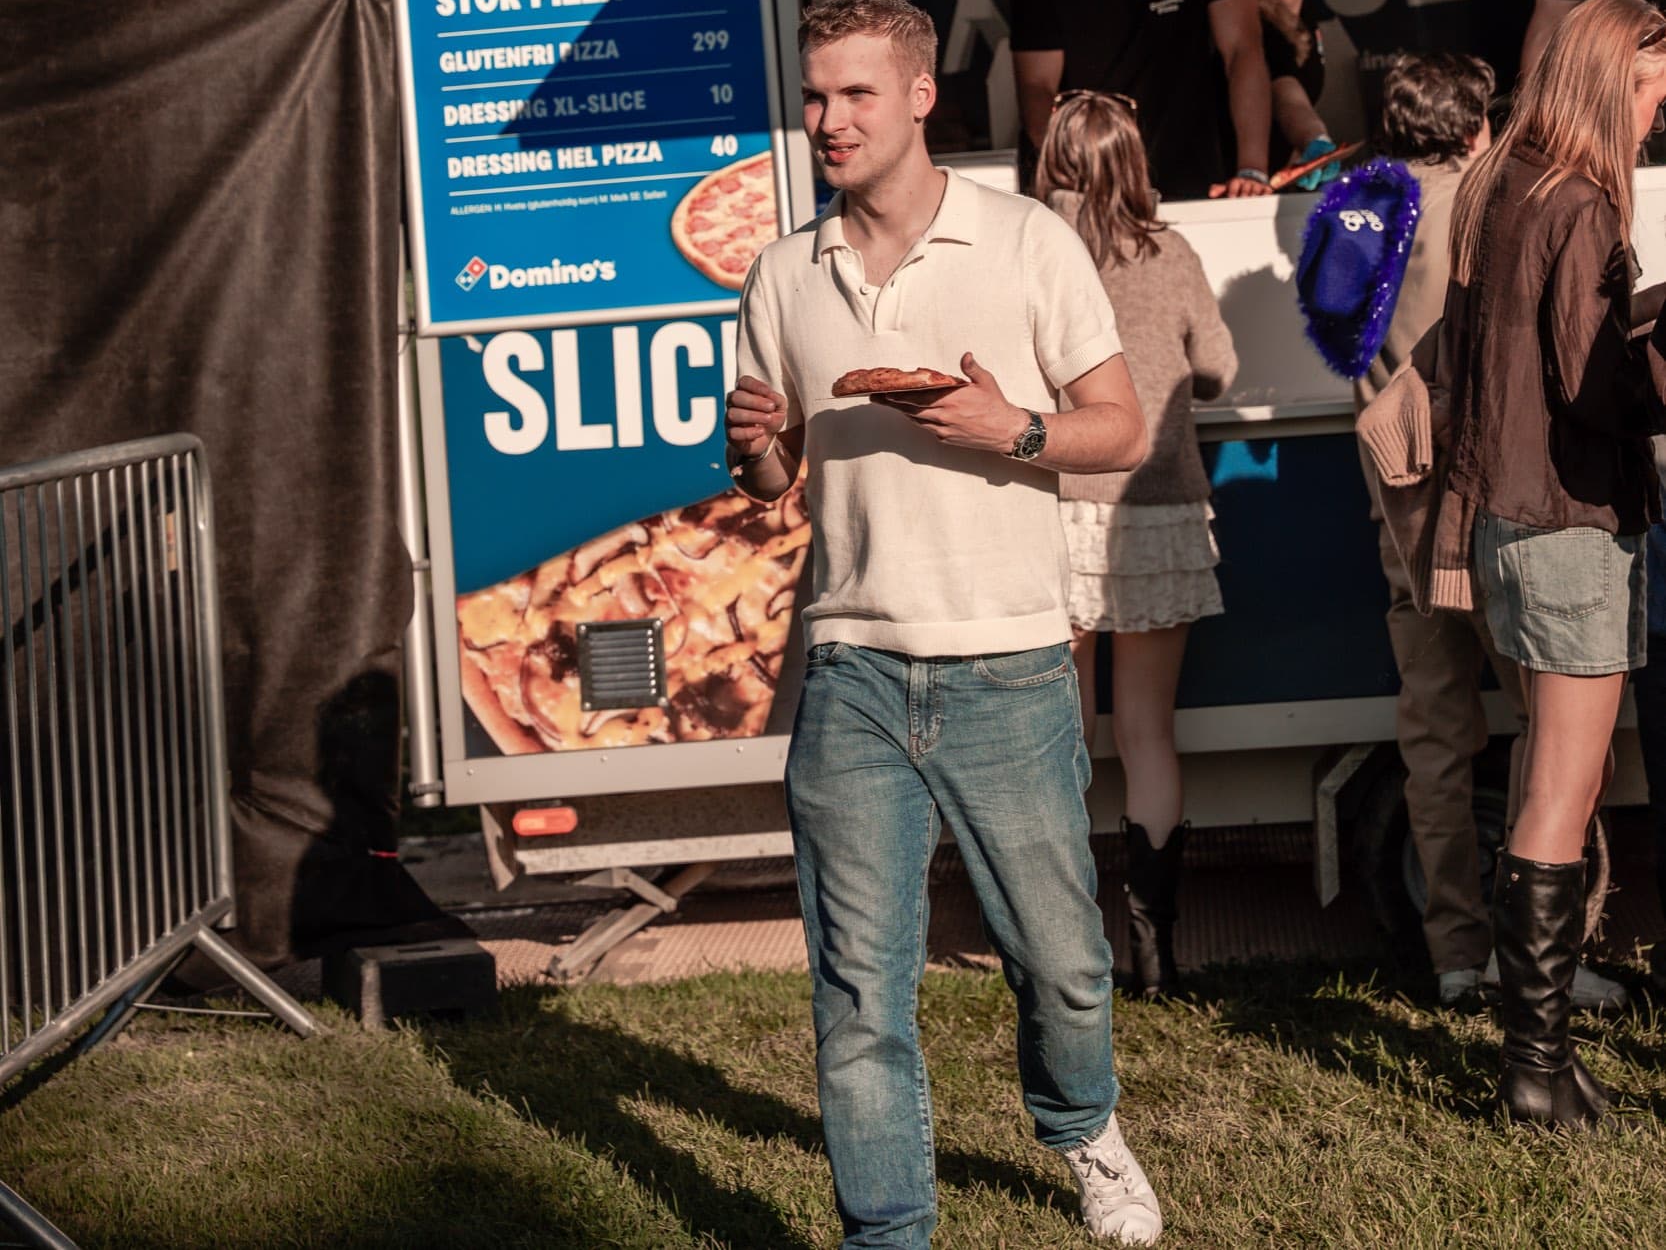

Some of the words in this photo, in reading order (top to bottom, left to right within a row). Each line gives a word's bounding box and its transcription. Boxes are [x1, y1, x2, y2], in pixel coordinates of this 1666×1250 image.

[440, 44, 555, 73] GLUTENFRI
[559, 40, 619, 61] PIZZA
[693, 30, 729, 52] 299
[444, 99, 547, 127] DRESSING
[554, 90, 646, 116] XL-SLICE
[710, 84, 733, 104] 10
[448, 150, 552, 179] DRESSING
[557, 146, 598, 170] HEL
[602, 141, 663, 166] PIZZA
[711, 135, 738, 157] 40
[488, 259, 617, 290] Domino's
